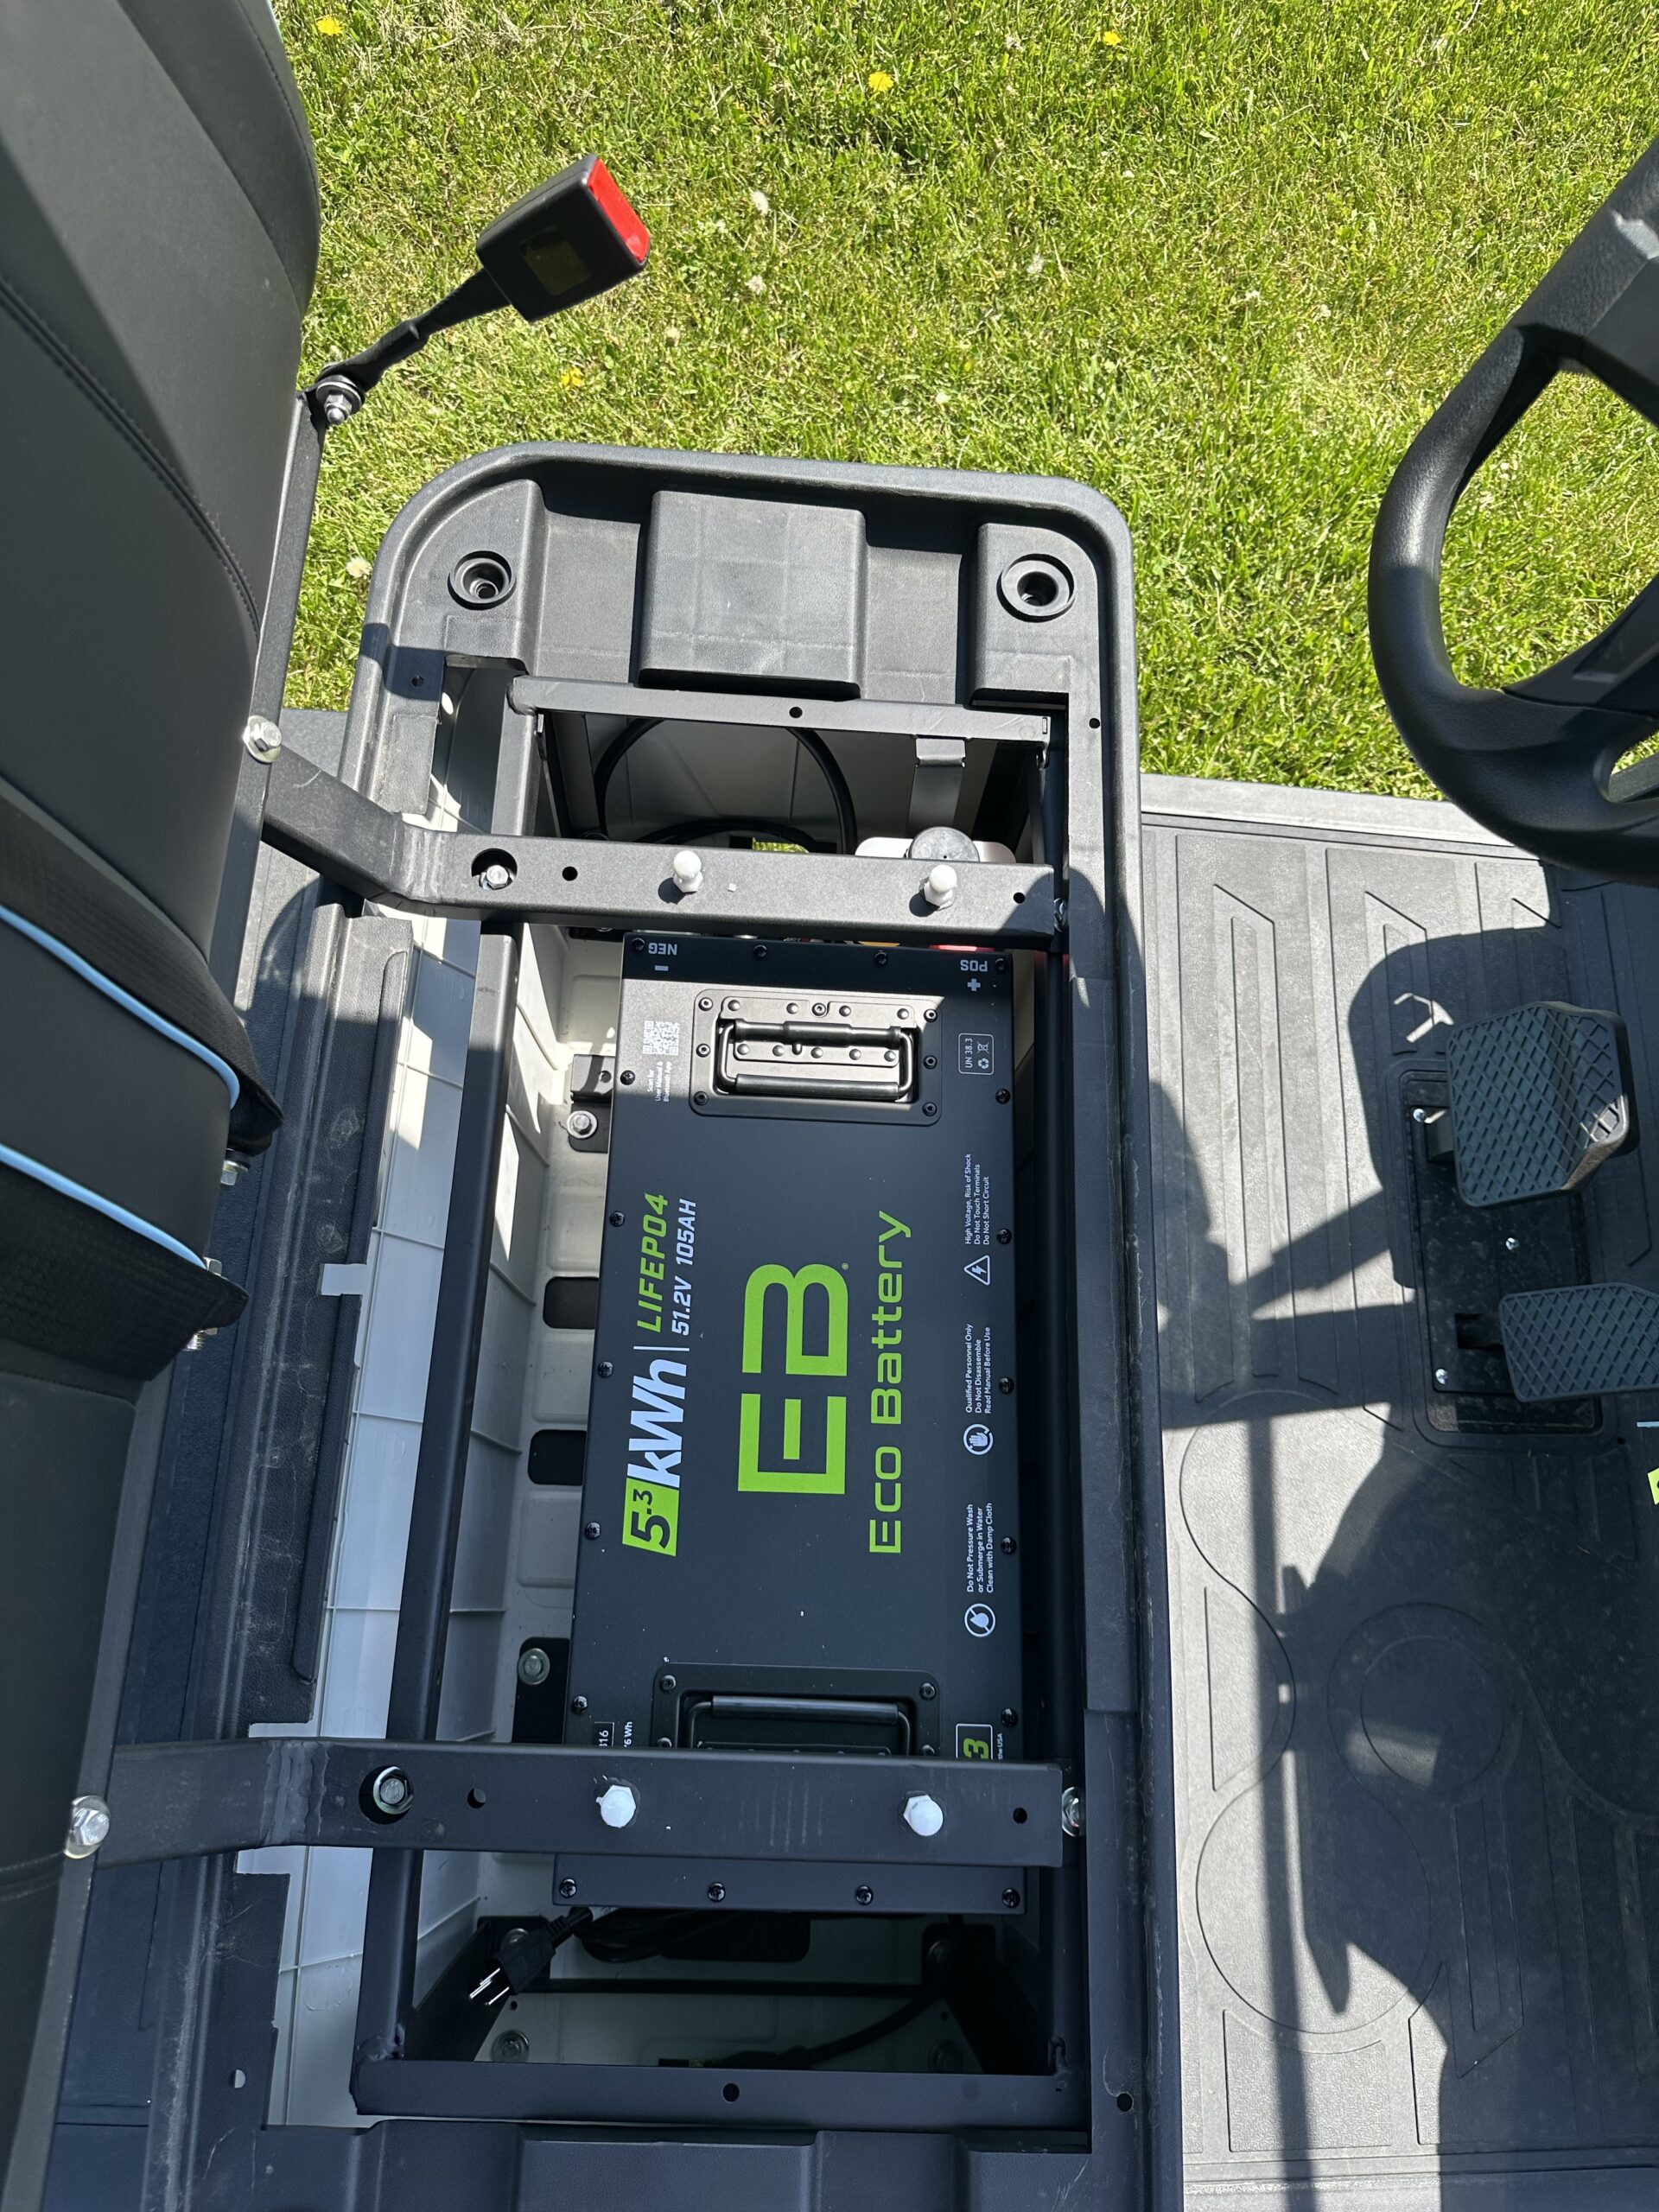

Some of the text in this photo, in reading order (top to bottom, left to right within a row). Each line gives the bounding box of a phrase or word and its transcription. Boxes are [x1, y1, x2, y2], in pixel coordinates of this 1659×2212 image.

[648, 942, 677, 956] NEG
[960, 958, 988, 972] POS
[964, 1038, 973, 1068] UN 38.3
[655, 1067, 664, 1087] Manual
[964, 1199, 973, 1227] Voltage,
[964, 1228, 973, 1244] High
[974, 1235, 981, 1244] Do
[983, 1235, 990, 1244] Do
[636, 1191, 671, 1333] LIFEPO4
[671, 1198, 697, 1336] 51.2V 105AH
[965, 1324, 974, 1341] Only
[737, 1262, 849, 1495] EB
[869, 1210, 912, 1554] Eco Battery
[975, 1403, 982, 1414] Do
[985, 1503, 994, 1524] Cloth
[976, 1541, 985, 1581] Submerge
[966, 1580, 974, 1592] Do
[977, 1583, 984, 1592] or
[624, 1721, 632, 1747] 6 Wh
[963, 1738, 989, 1759] 3
